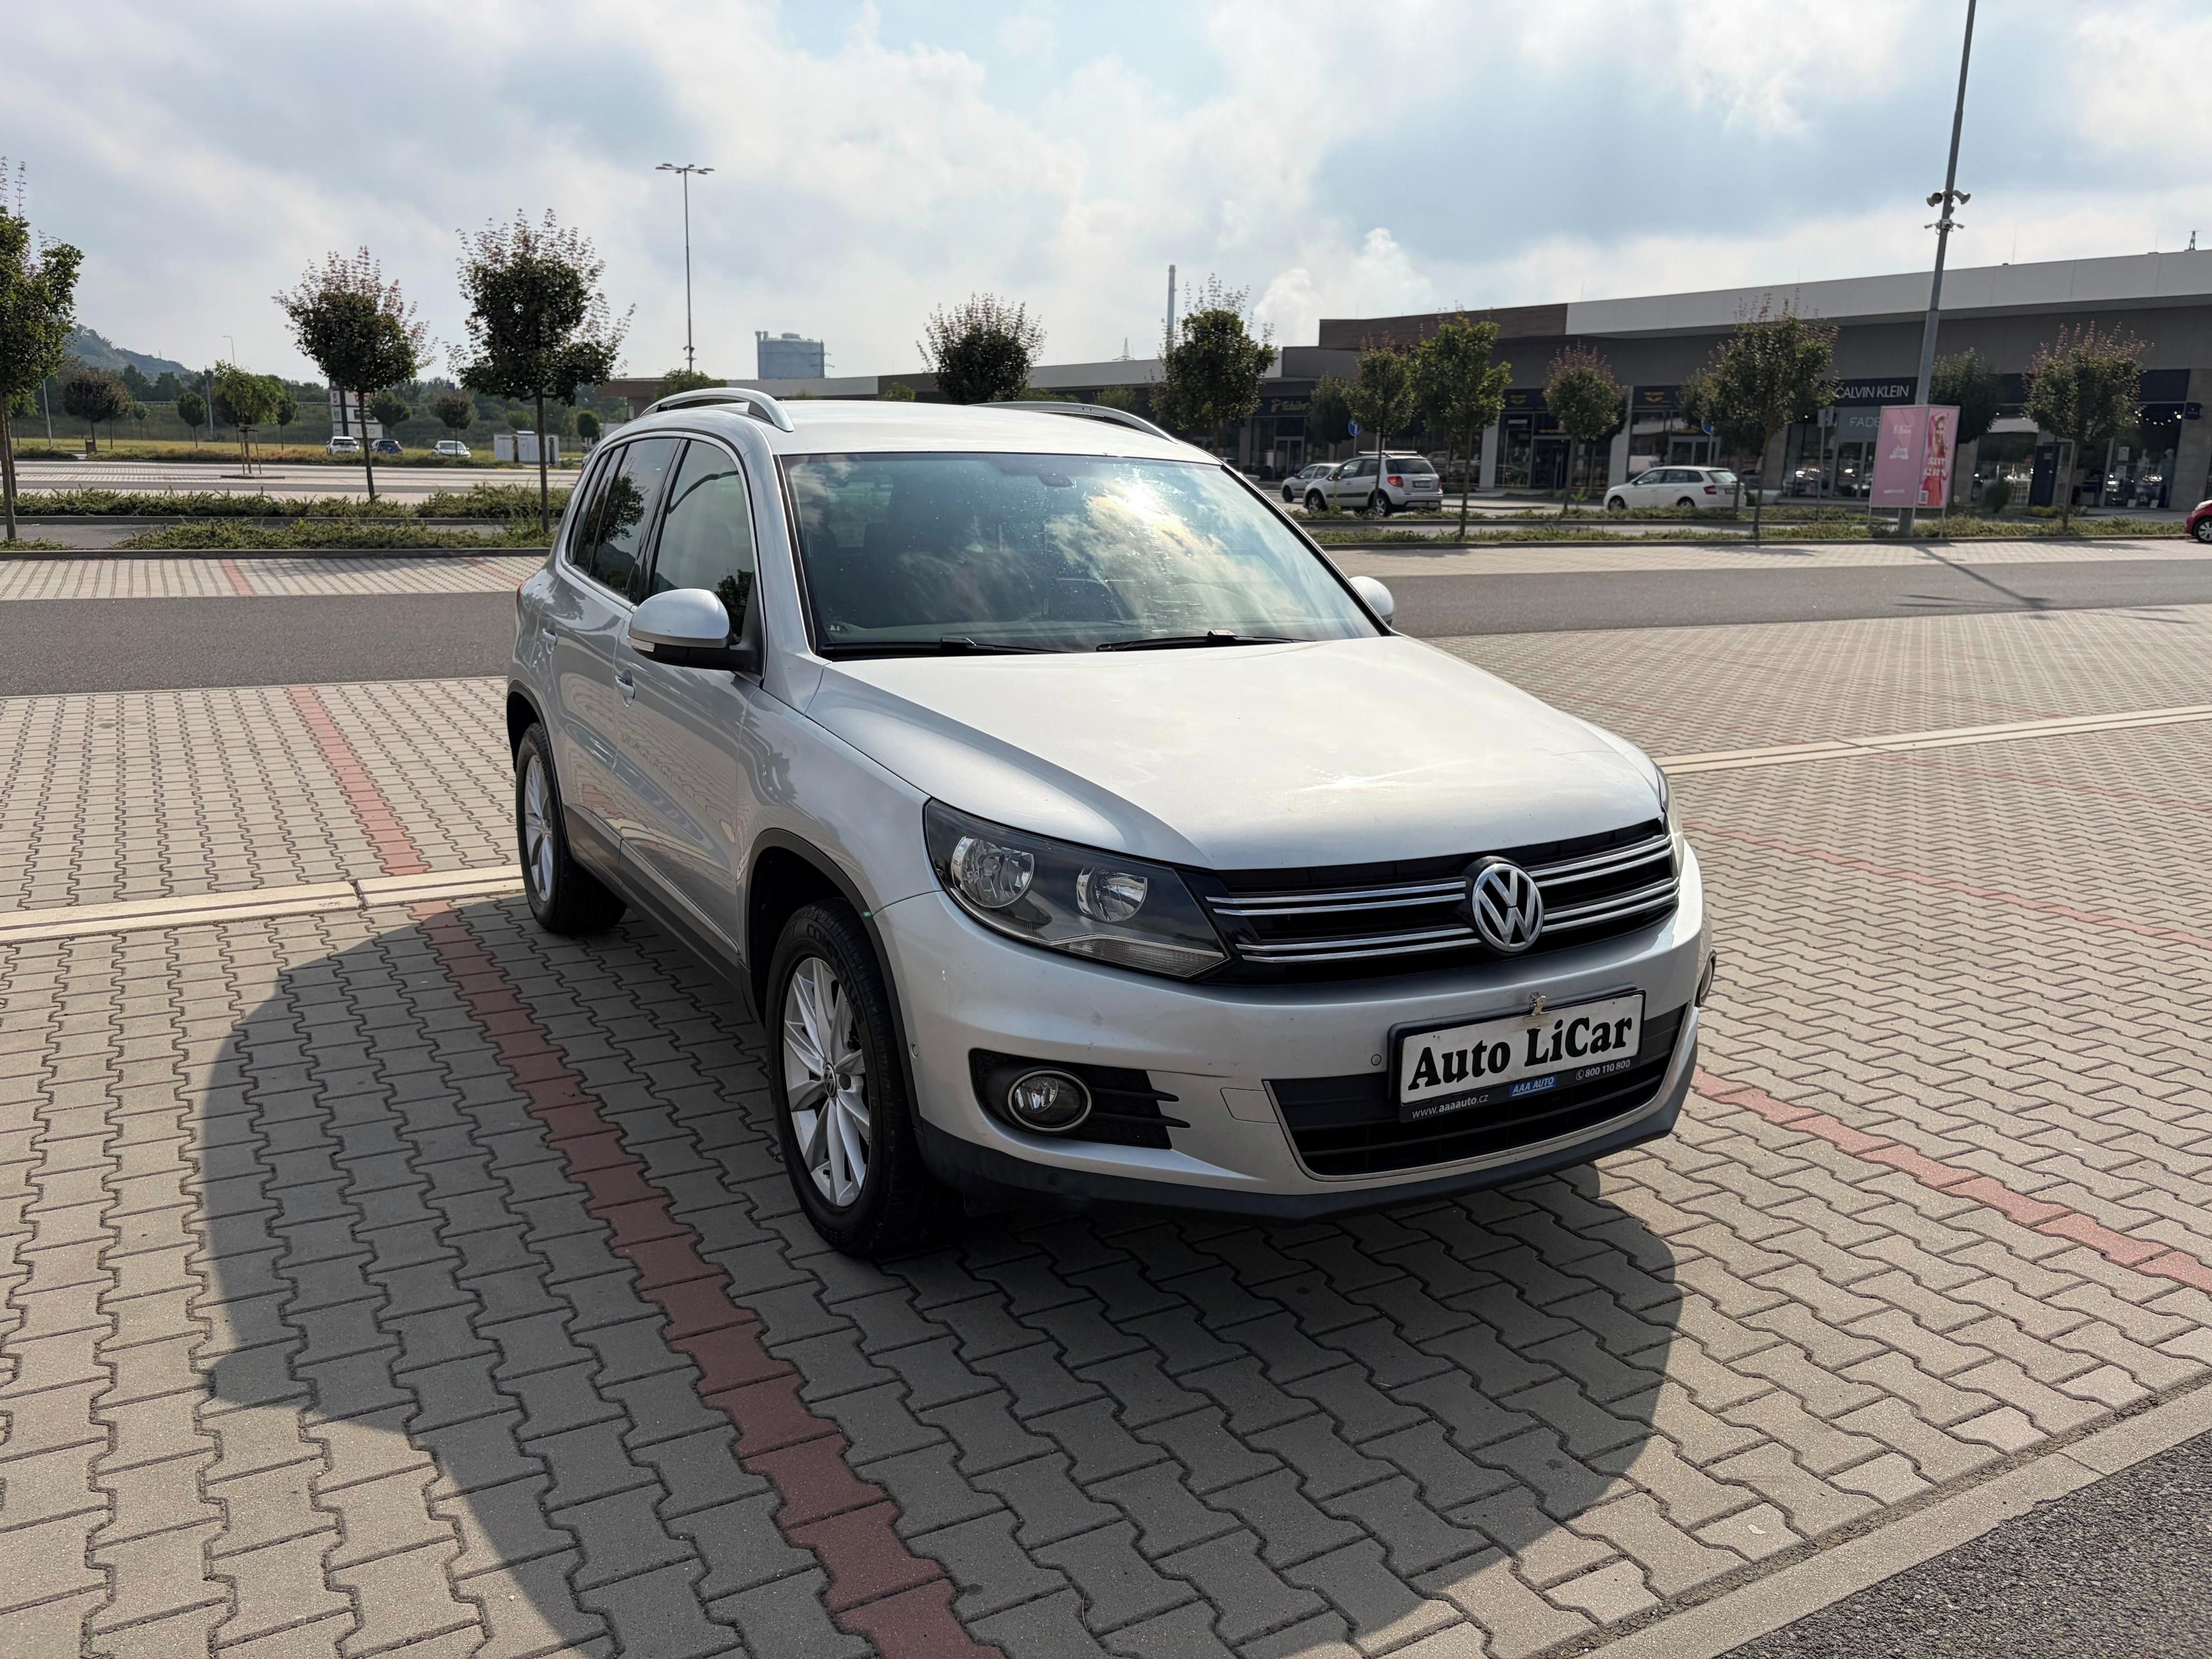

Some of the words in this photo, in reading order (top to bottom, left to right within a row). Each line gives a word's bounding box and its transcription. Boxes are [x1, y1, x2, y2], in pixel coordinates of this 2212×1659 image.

[1836, 386, 1875, 399] CALVIN
[1877, 385, 1910, 398] KLEIN
[1473, 864, 1543, 952] VW
[1408, 1040, 1510, 1091] Auto
[1524, 1016, 1632, 1067] LiCar
[1585, 1067, 1600, 1077] 800
[1602, 1063, 1615, 1074] 110
[1616, 1059, 1630, 1070] 800
[1513, 1082, 1530, 1094] AAA
[1534, 1076, 1554, 1089] AUTO
[1412, 1094, 1489, 1118] www.aaaauto.cz
